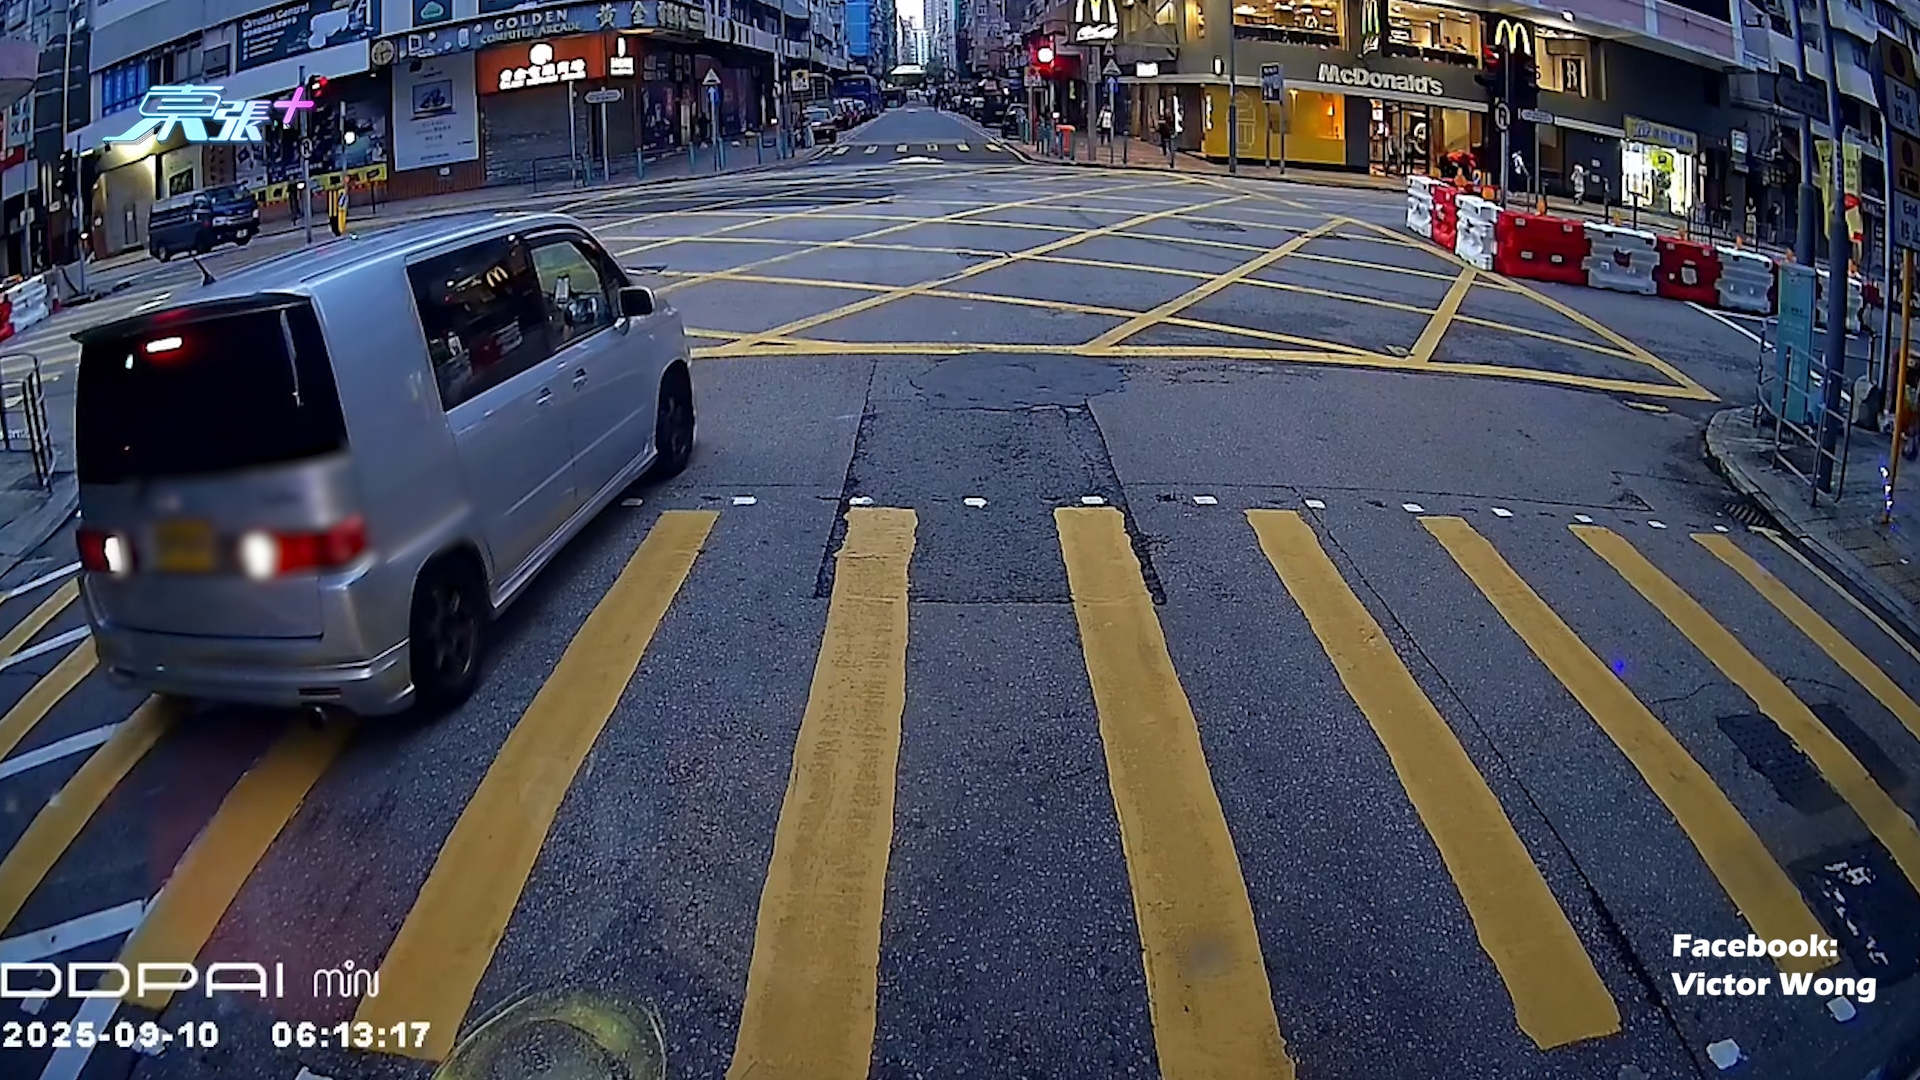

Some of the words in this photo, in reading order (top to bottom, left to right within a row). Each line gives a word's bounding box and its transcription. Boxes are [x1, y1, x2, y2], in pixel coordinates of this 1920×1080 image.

[493, 8, 569, 32] GOLDEN
[1318, 63, 1444, 96] McDonald's
[1894, 84, 1909, 104] End
[1903, 200, 1917, 219] End
